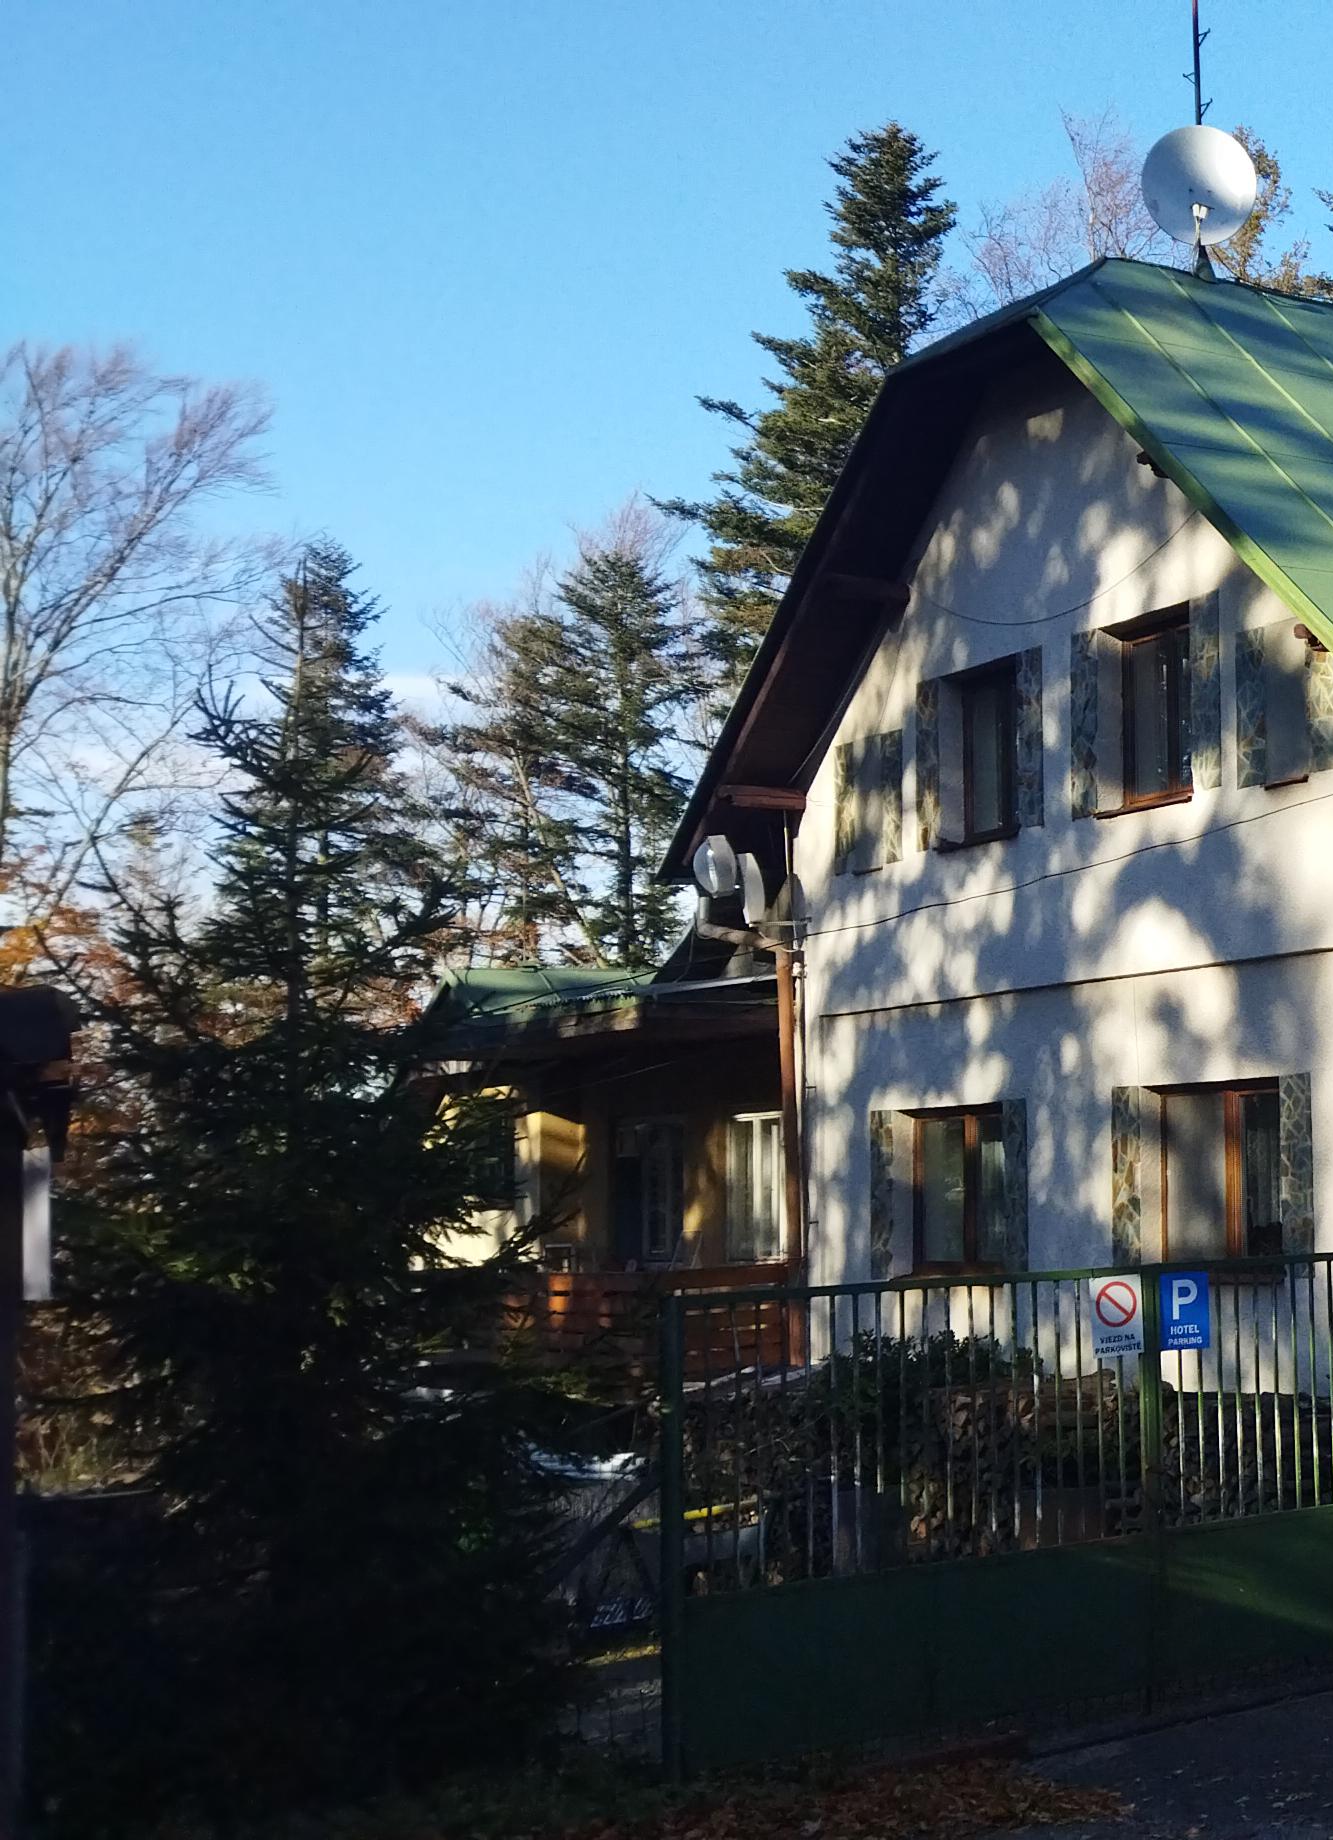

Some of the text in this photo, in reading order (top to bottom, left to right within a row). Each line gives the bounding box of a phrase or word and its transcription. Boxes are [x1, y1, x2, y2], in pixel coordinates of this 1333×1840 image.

[1171, 1278, 1198, 1321] P
[1170, 1324, 1200, 1335] HOTEL
[1124, 1333, 1136, 1341] NA
[1167, 1336, 1203, 1347] PARKING
